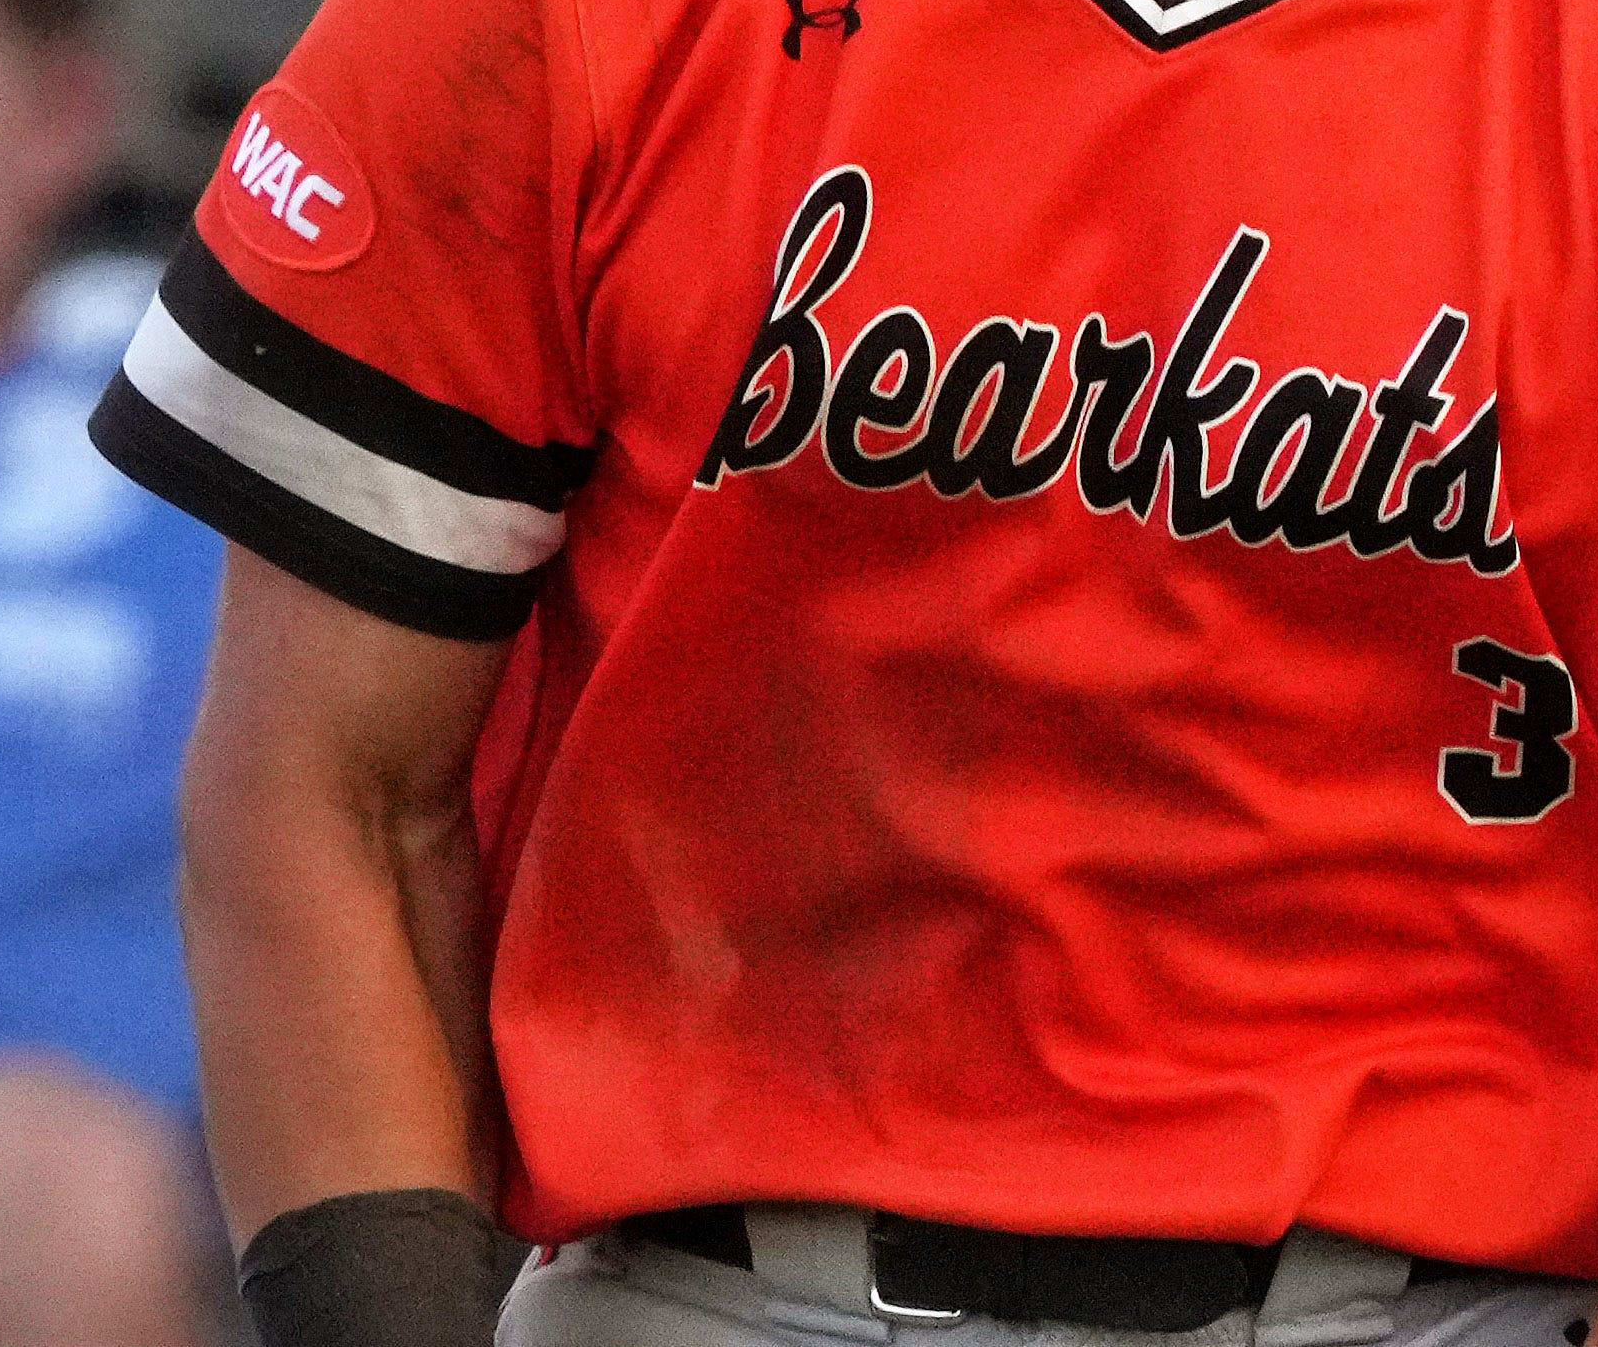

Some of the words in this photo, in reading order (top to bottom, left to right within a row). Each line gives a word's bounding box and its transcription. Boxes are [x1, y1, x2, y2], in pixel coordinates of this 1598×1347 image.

[232, 110, 346, 243] WAC
[692, 163, 1521, 579] Bearkats
[1436, 634, 1579, 826] 3
